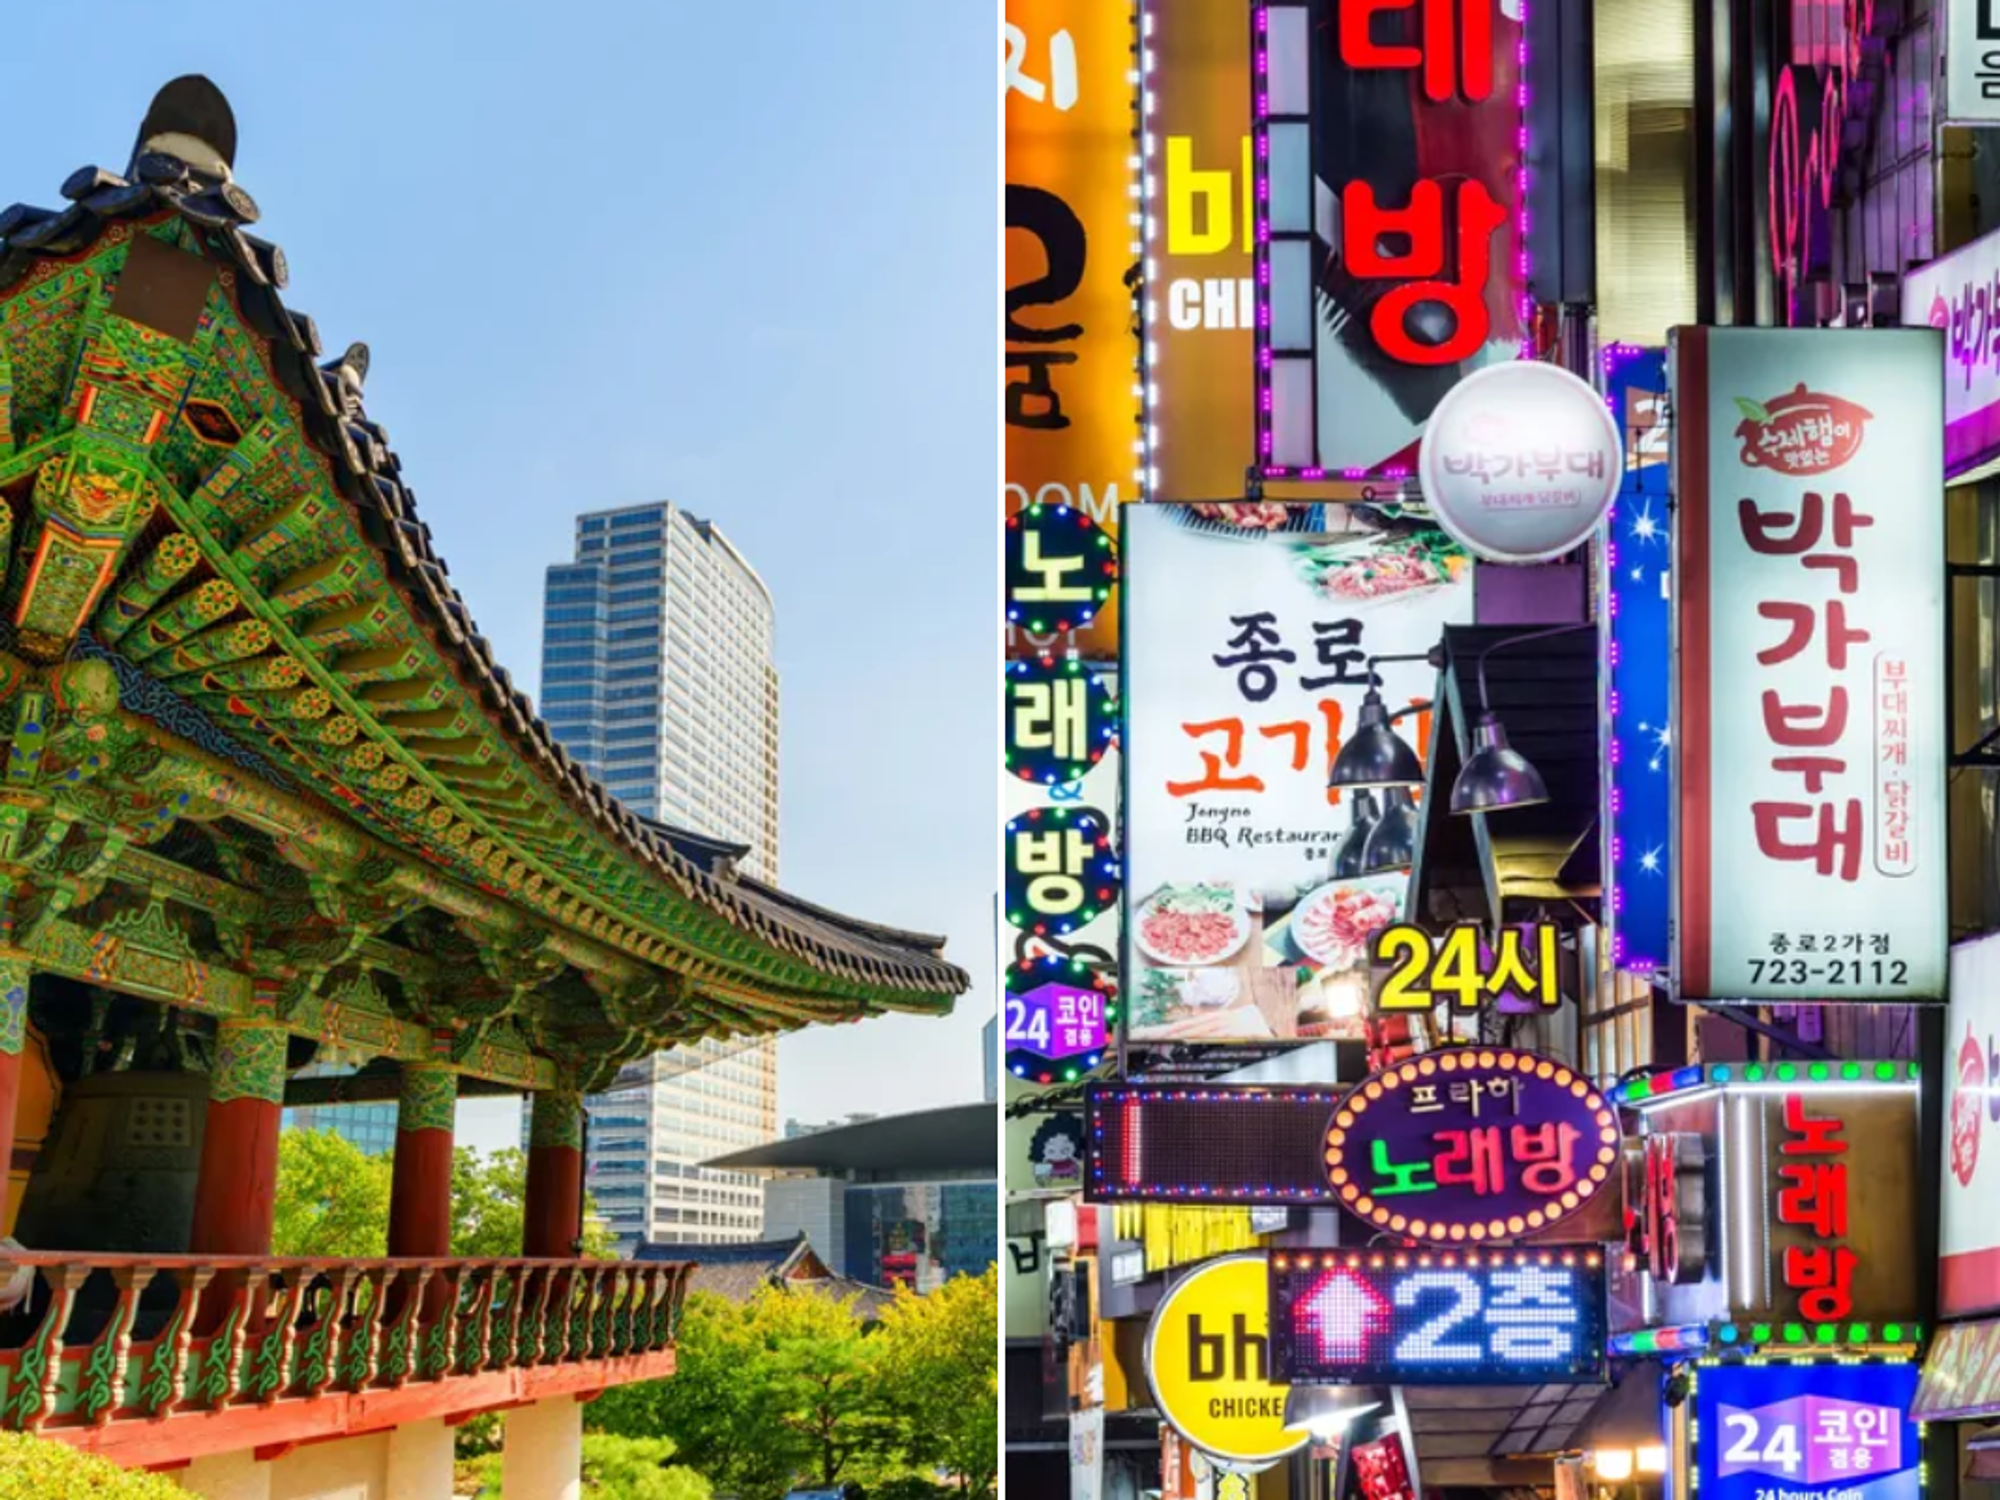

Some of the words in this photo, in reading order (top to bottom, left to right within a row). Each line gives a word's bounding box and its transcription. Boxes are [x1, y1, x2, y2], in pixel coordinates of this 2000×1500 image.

[1951, 268, 2000, 391] 박가
[1443, 447, 1604, 484] 박가부대
[1212, 612, 1383, 702] 종로
[1738, 493, 1873, 881] 박가부대
[1186, 827, 1229, 848] BBQ
[1377, 925, 1557, 1008] 24시
[1748, 959, 1908, 985] 723-2112
[1769, 933, 1889, 954] 종로2가점
[1005, 999, 1049, 1049] 24
[1056, 995, 1099, 1025] 코인
[1410, 1077, 1524, 1117] 프라하
[1371, 1122, 1581, 1196] 노래방
[1779, 1092, 1859, 1322] 노래방
[1394, 1266, 1576, 1359] 2층
[1187, 1314, 1268, 1382] bh
[1209, 1397, 1282, 1418] CHICKE
[1724, 1412, 1802, 1473] 24
[1814, 1408, 1889, 1446] 코인
